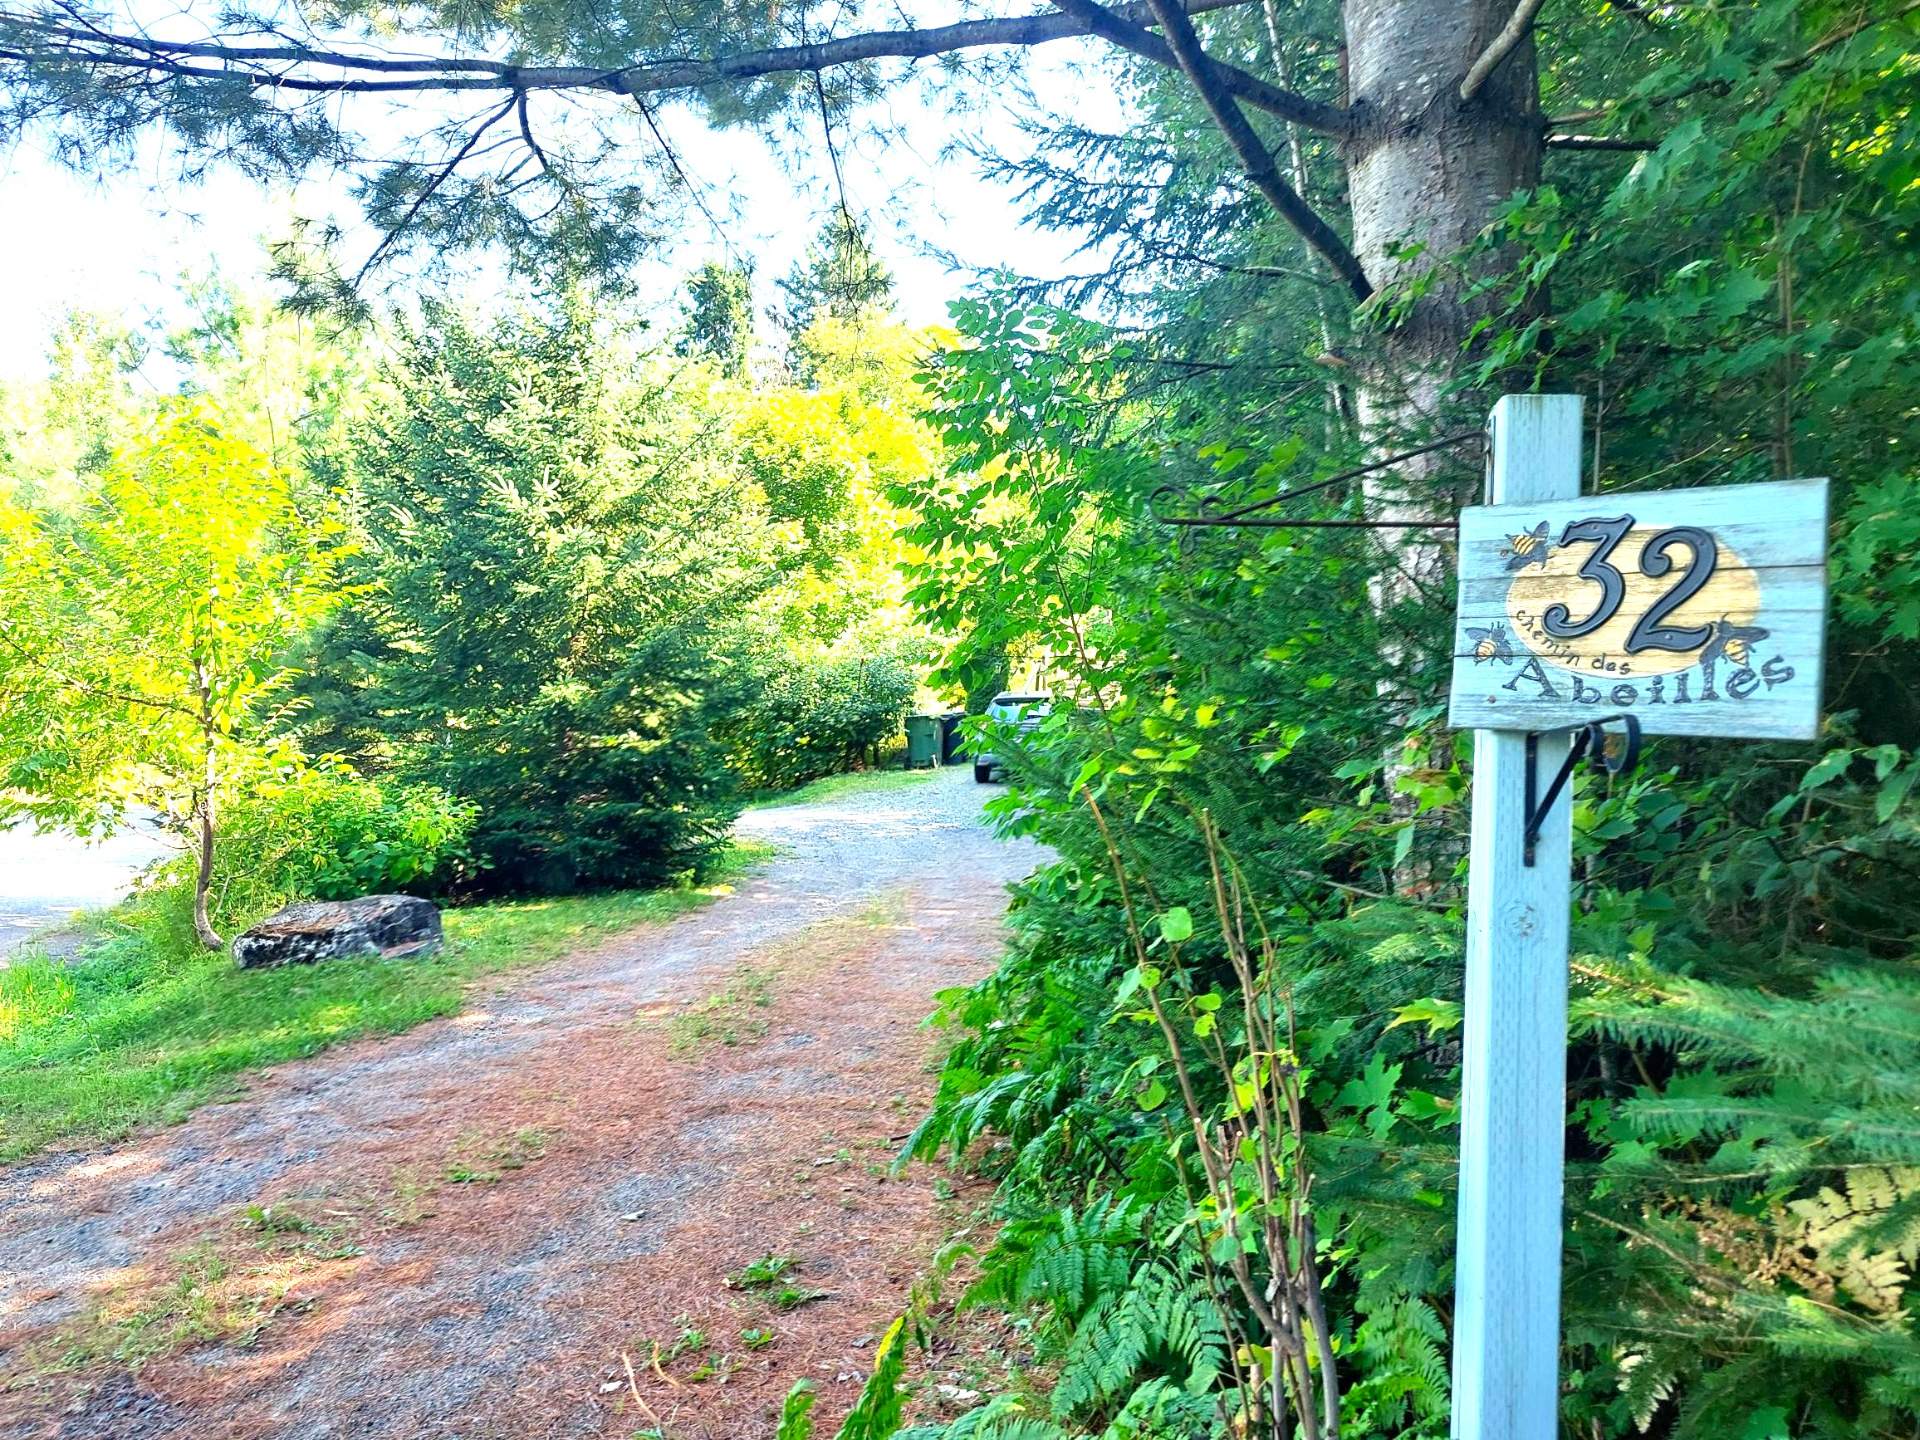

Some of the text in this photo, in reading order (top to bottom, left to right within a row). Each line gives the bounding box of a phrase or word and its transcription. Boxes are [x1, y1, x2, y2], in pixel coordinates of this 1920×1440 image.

[1542, 513, 1718, 654] 32
[1502, 655, 1795, 706] Abeilles
[1592, 652, 1631, 675] des
